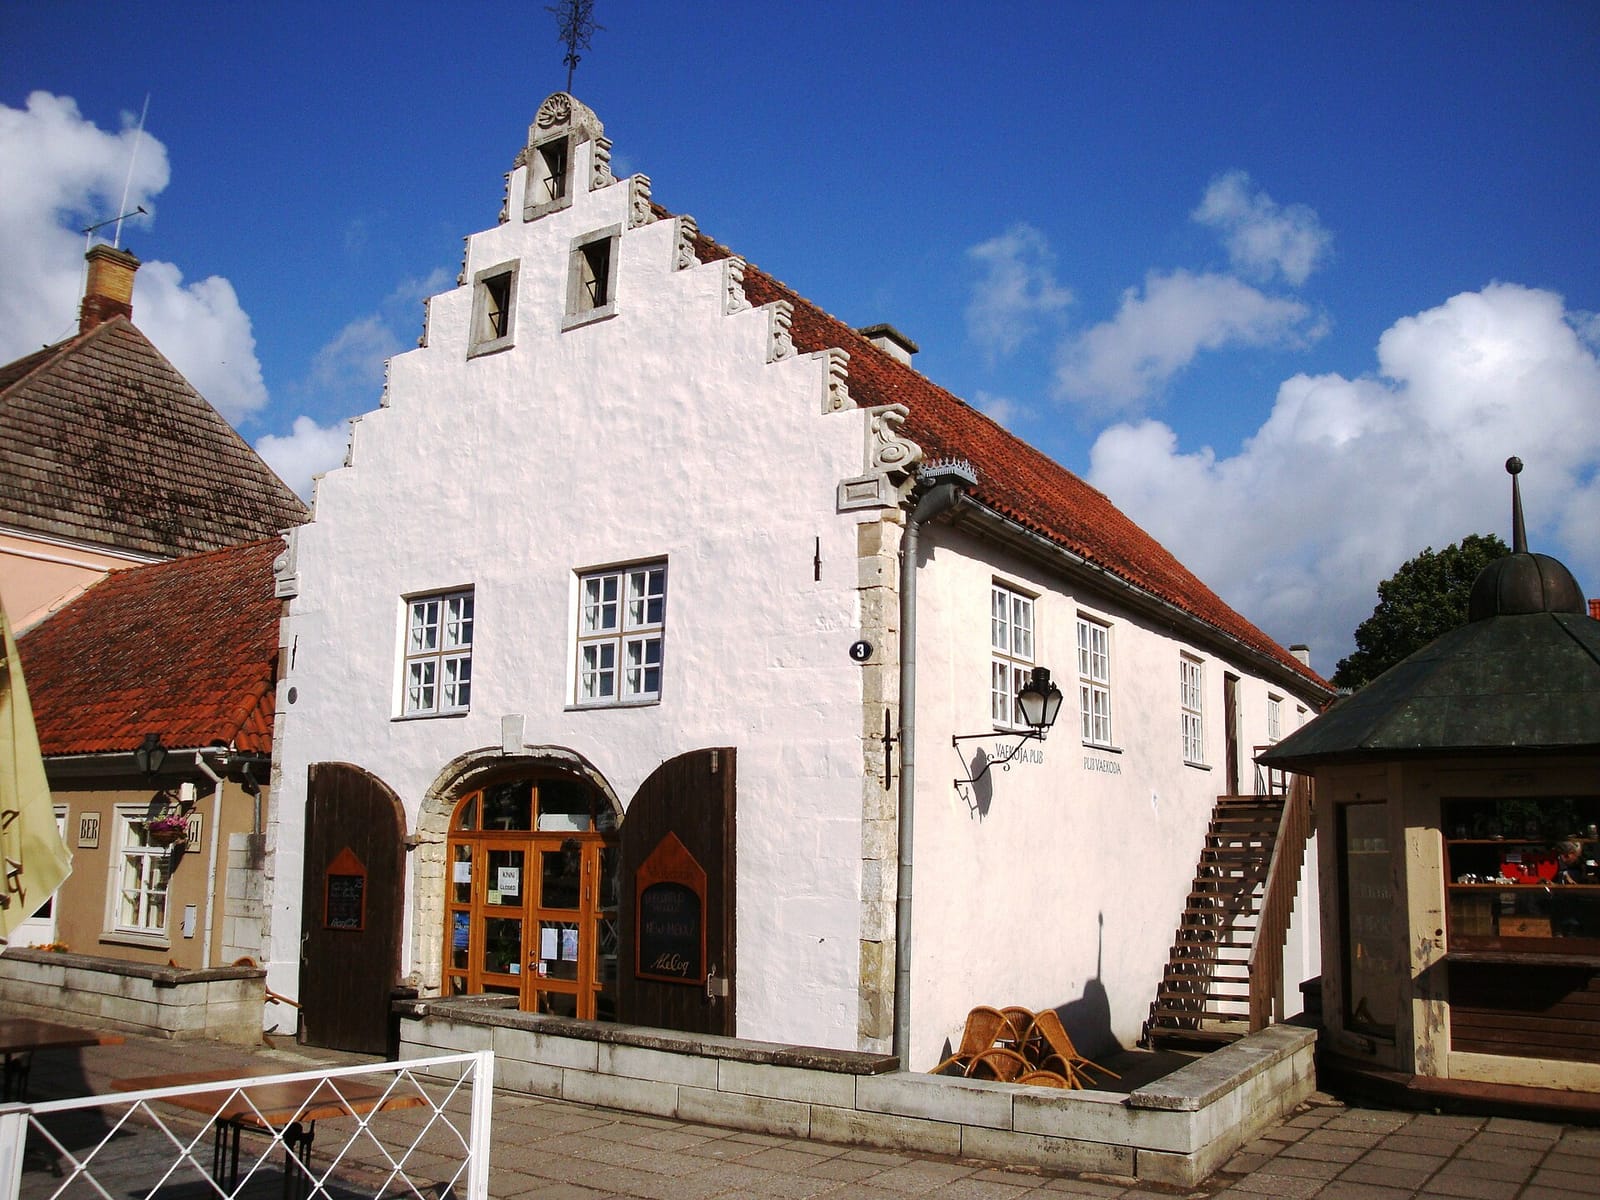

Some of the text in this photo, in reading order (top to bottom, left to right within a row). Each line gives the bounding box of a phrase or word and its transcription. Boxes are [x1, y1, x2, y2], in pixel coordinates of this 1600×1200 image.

[856, 643, 865, 658] 3
[1029, 749, 1044, 765] PUB
[1083, 756, 1095, 771] PUB
[80, 819, 98, 839] BER
